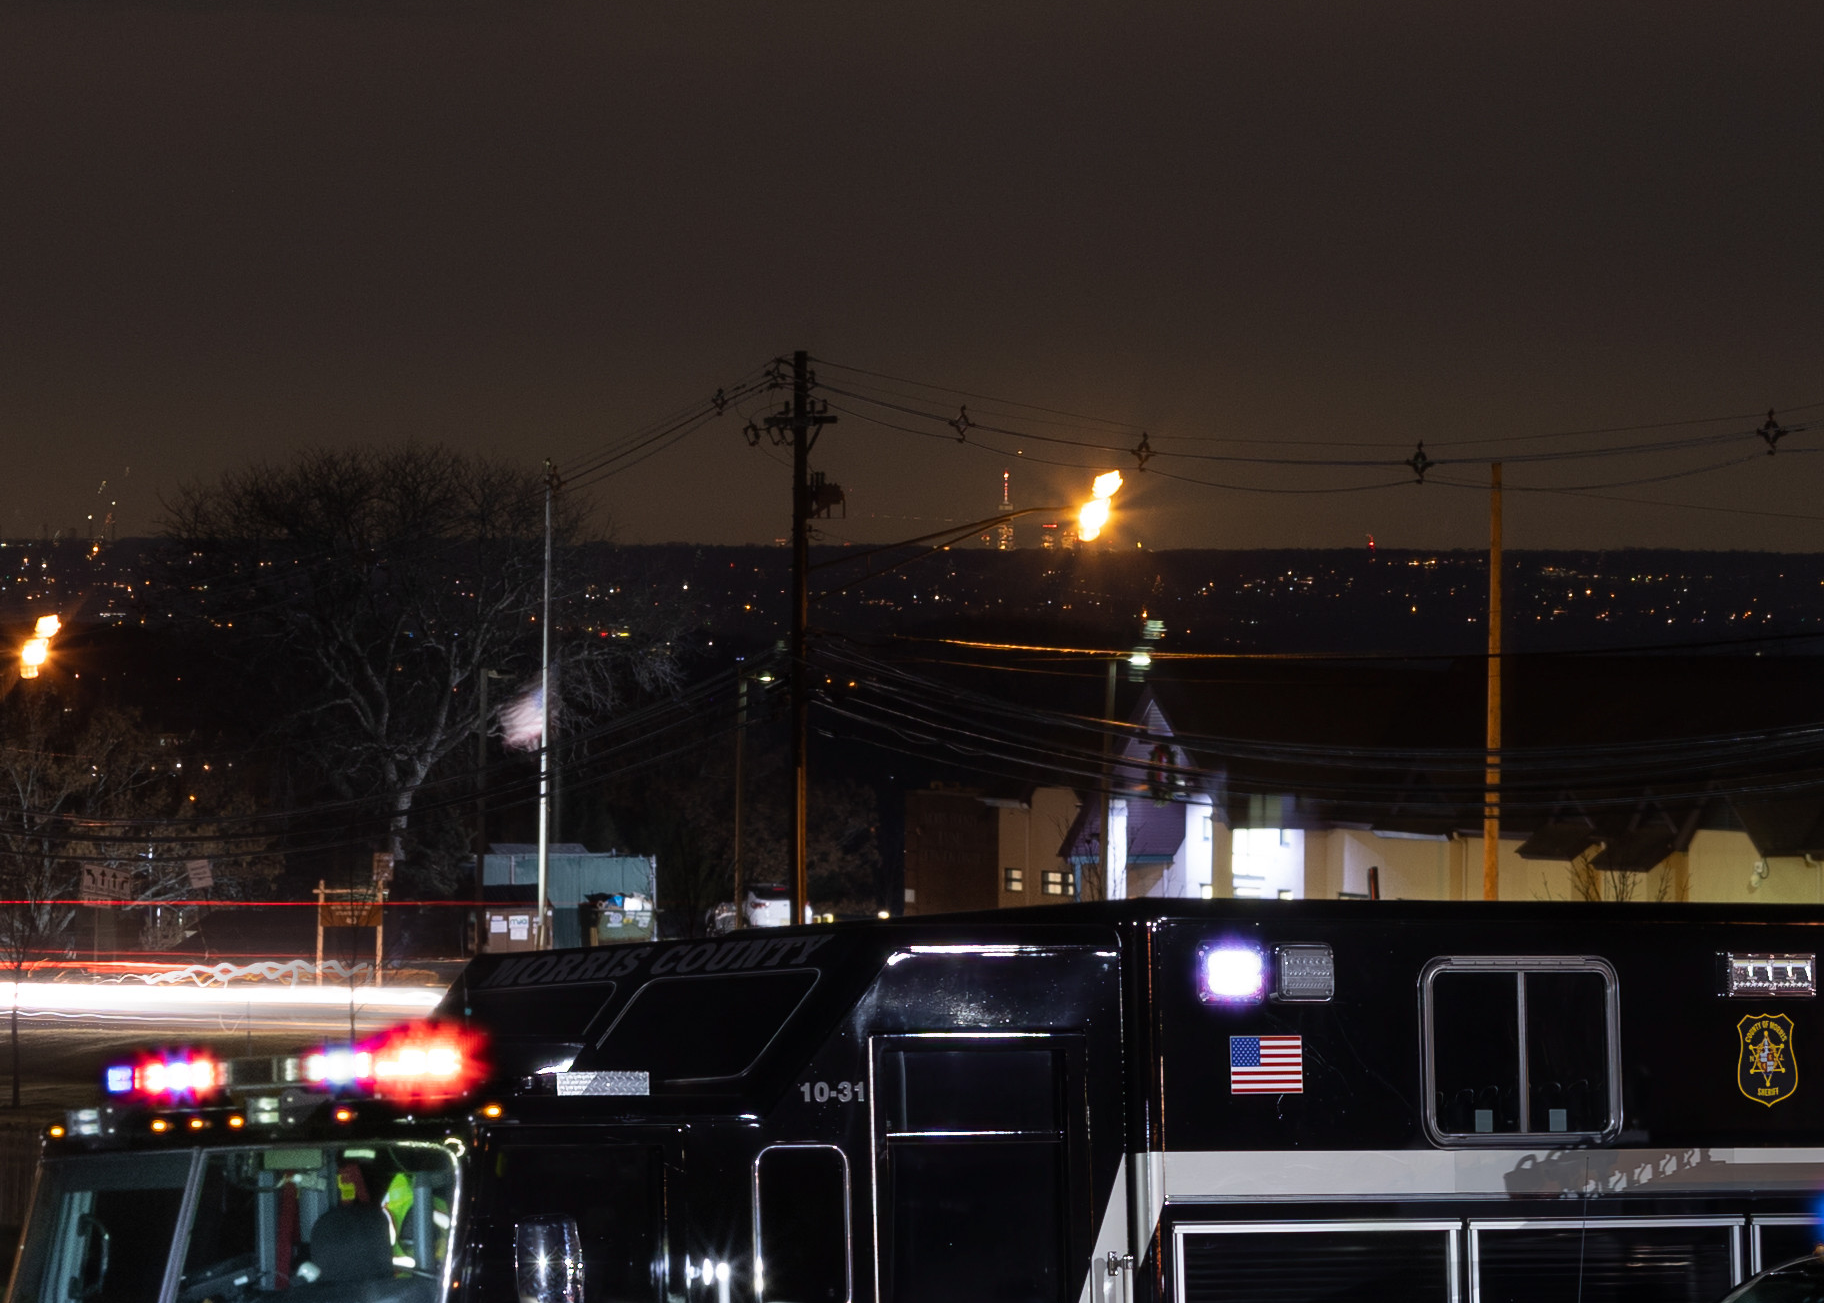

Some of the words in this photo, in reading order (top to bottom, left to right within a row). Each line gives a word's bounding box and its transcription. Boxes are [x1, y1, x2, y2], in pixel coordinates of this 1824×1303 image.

[488, 946, 655, 988] MORRIS
[657, 933, 837, 974] COUNTY
[800, 1081, 865, 1103] 10-31
[1757, 1087, 1779, 1097] SHERIFF
